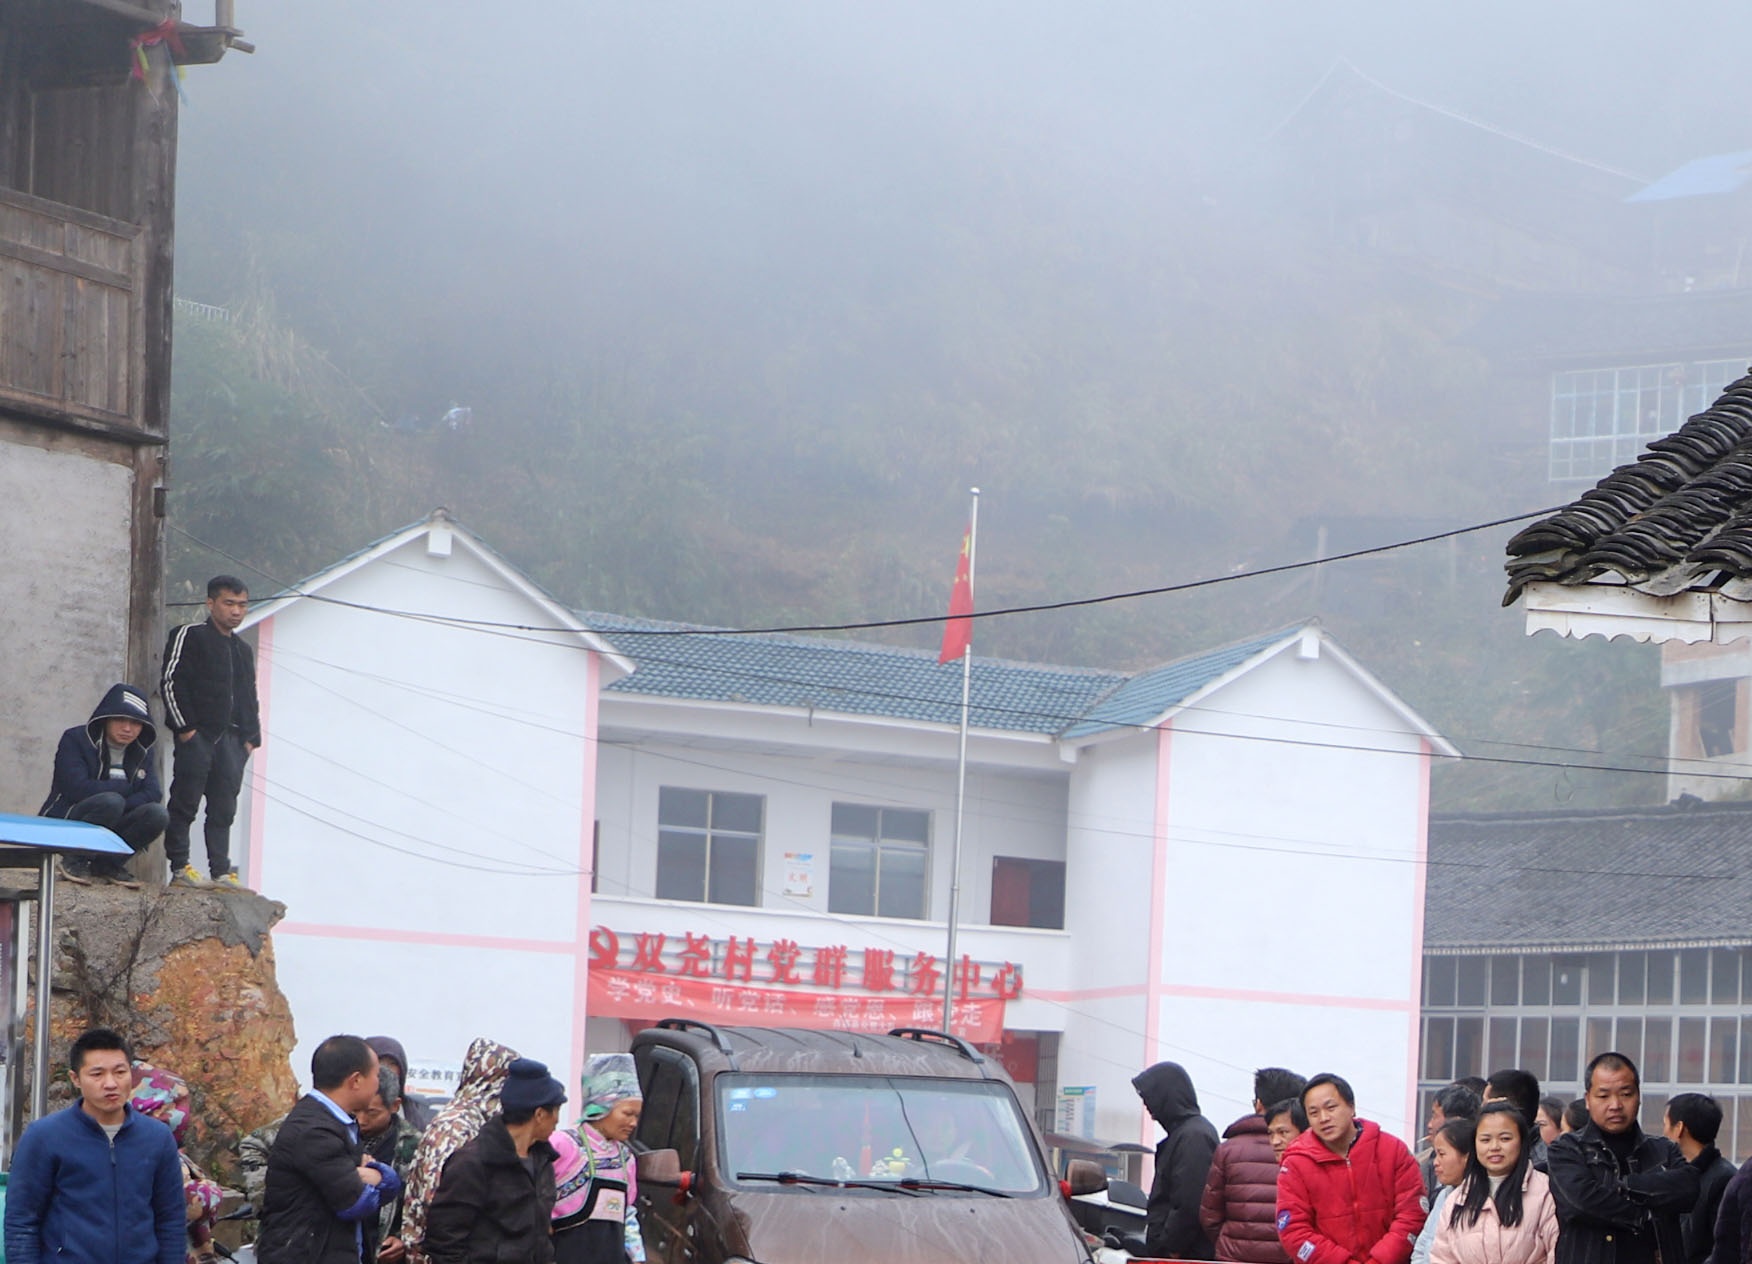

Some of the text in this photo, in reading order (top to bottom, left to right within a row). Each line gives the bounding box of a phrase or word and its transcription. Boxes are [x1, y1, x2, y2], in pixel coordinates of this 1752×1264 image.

[631, 931, 1024, 1000] 双尧村党群服务中心
